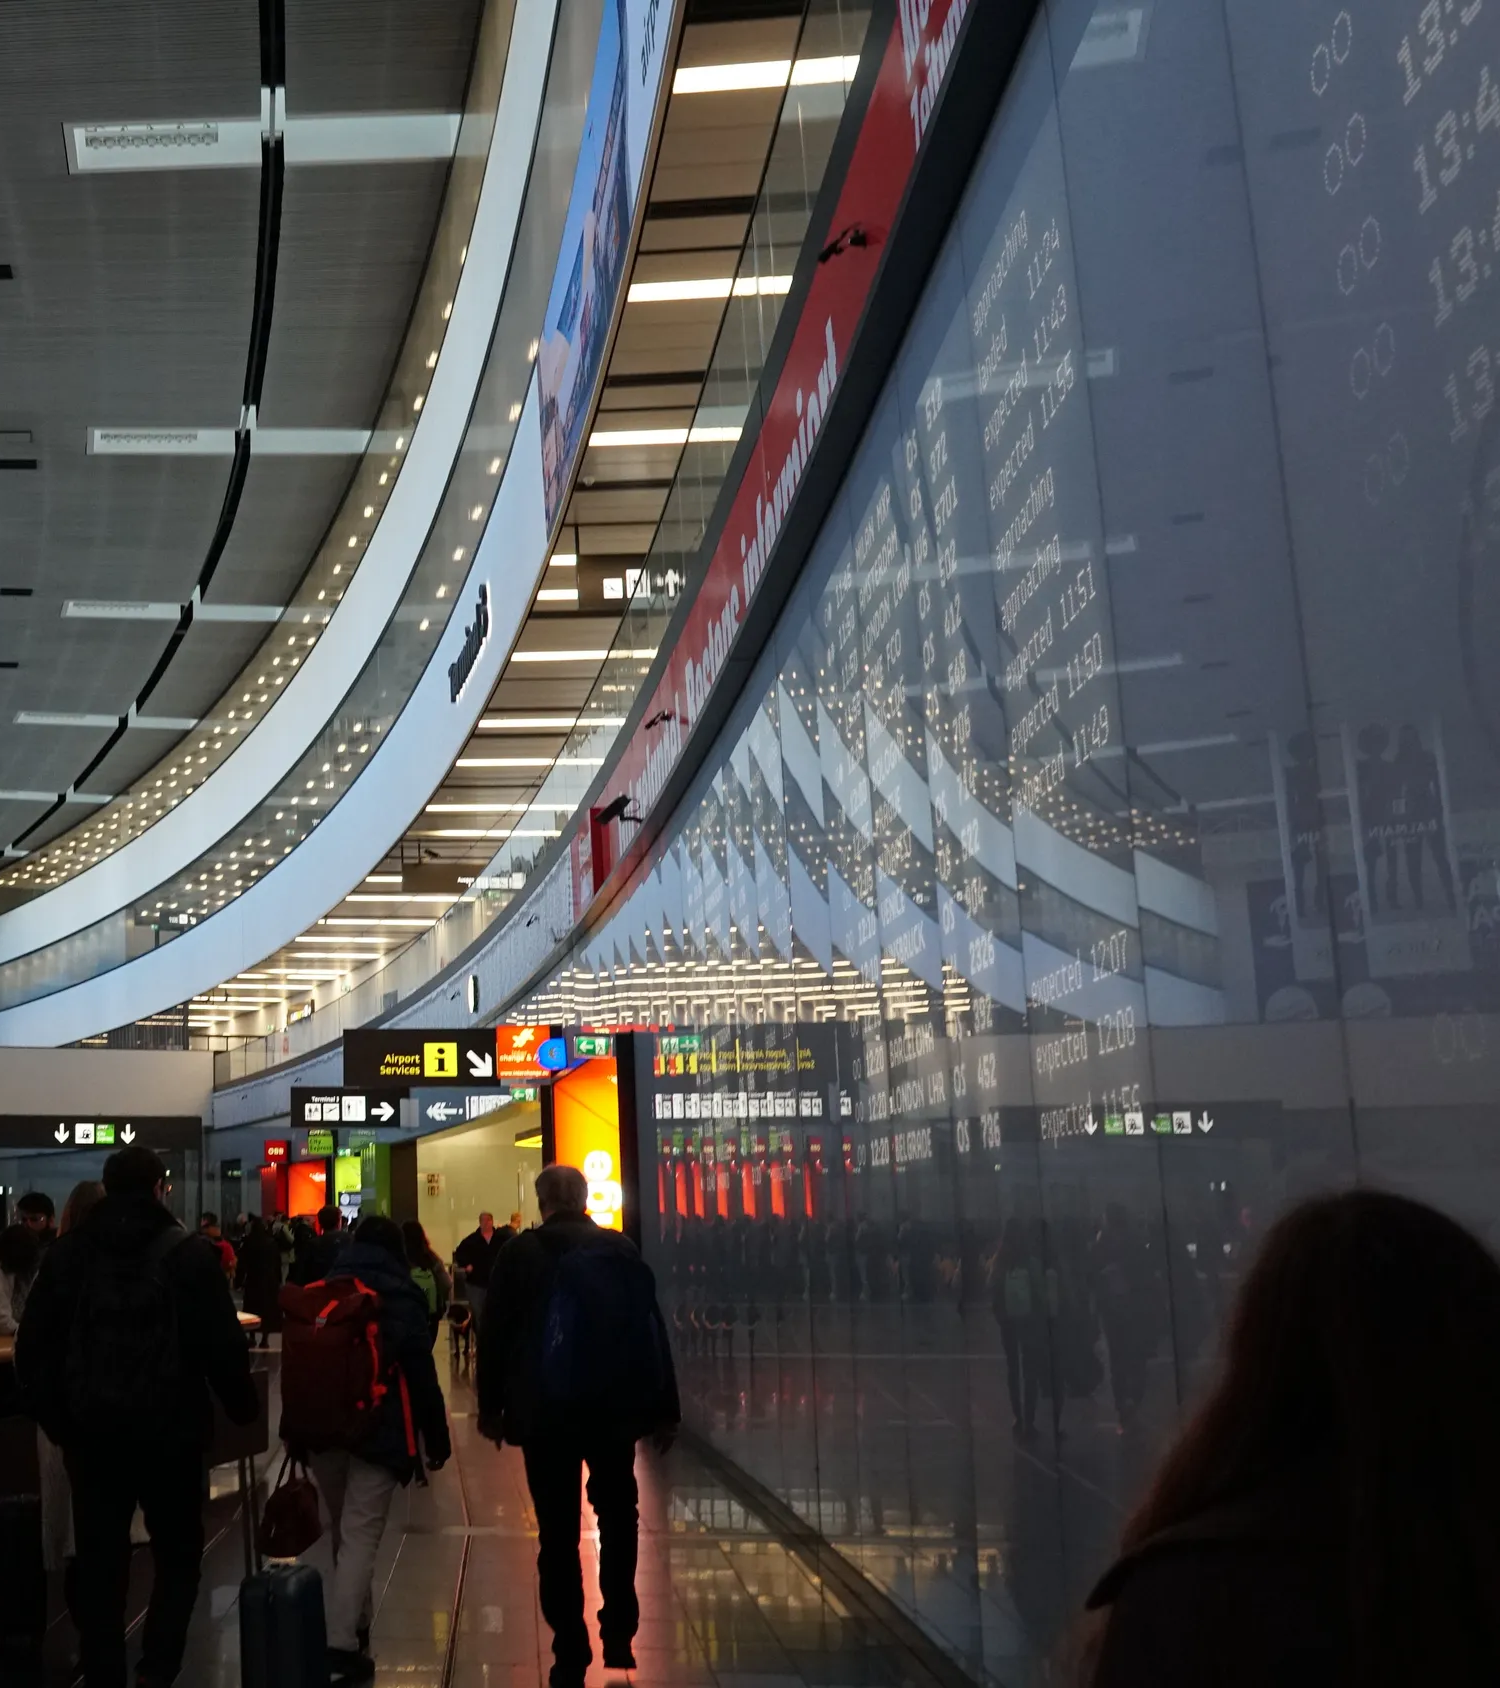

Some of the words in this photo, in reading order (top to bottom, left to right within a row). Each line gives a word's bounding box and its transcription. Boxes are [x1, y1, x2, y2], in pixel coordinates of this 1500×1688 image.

[856, 516, 874, 569] MILAN
[877, 484, 890, 529] MXP
[972, 202, 1029, 339] approaching
[860, 526, 897, 610] AMSTERDAM
[931, 432, 947, 483] 372
[978, 315, 1007, 393] landed
[1027, 219, 1059, 298] 11:24
[863, 593, 890, 657] LONDON
[935, 477, 957, 534] 5701
[983, 345, 1028, 455] expected
[1034, 285, 1066, 363] 11:43
[886, 629, 901, 669] FCO
[919, 582, 930, 619] OS
[939, 539, 957, 587] 502
[989, 407, 1034, 514] expected
[1041, 350, 1073, 428] 11:55
[923, 632, 934, 670] OS
[945, 593, 961, 637] 412
[995, 463, 1055, 573] approaching
[948, 649, 966, 694] 548
[1000, 531, 1061, 632] approaching
[1006, 603, 1053, 692] expected
[1060, 564, 1095, 628] 11:51
[1011, 670, 1059, 755] expected
[1067, 634, 1102, 697] 11:50
[1016, 739, 1065, 817] expected
[1073, 706, 1108, 767] 11:49
[866, 1045, 884, 1077] 12:20
[890, 1023, 934, 1066] BARCELONA
[1030, 947, 1083, 1014] expected
[1091, 930, 1126, 981] 12:07
[970, 931, 994, 975] 2326
[380, 1065, 421, 1076] Services
[384, 1053, 421, 1066] Airport
[869, 1092, 886, 1121] 12:20
[894, 1080, 924, 1113] LONDON
[929, 1072, 945, 1104] LHR
[954, 1063, 966, 1097] OS
[978, 1053, 996, 1088] 452
[1035, 1019, 1088, 1081] expected
[1097, 1007, 1135, 1054] 12:08
[871, 1137, 889, 1166] 12:20
[895, 1128, 932, 1161] BELGRADE
[957, 1120, 969, 1152] OS
[981, 1113, 1000, 1147] 736
[1040, 1090, 1094, 1148] expected
